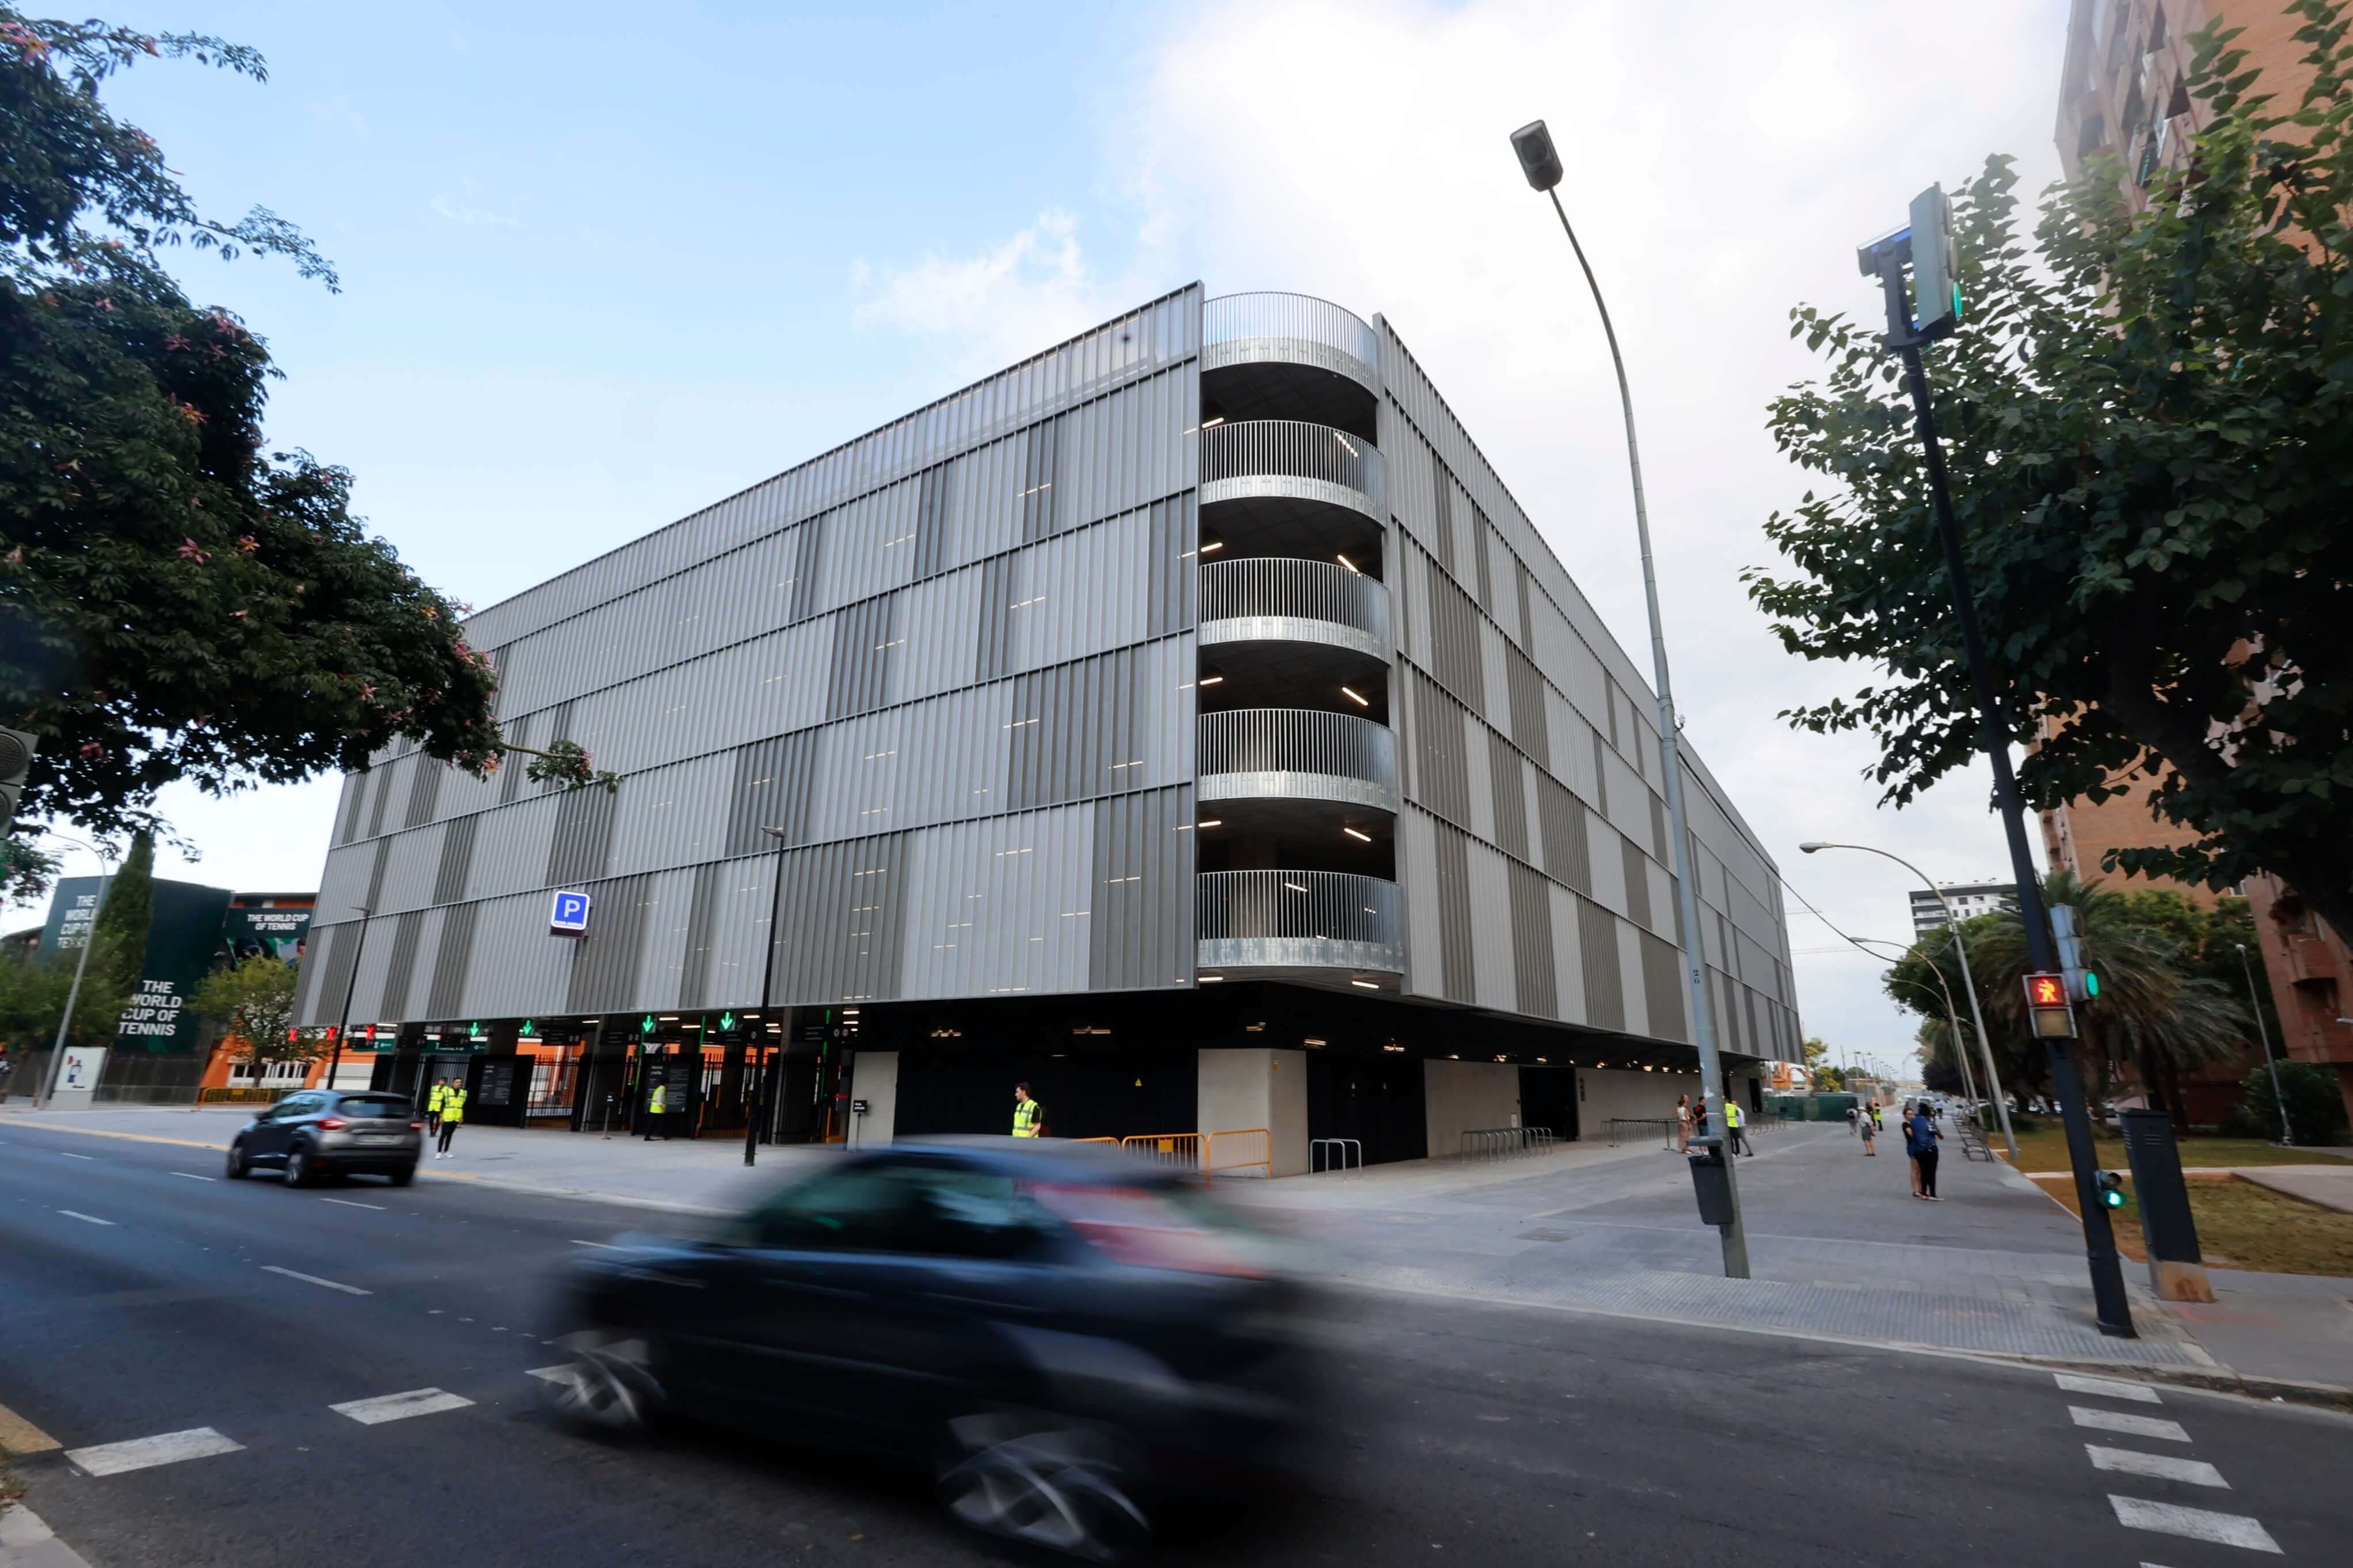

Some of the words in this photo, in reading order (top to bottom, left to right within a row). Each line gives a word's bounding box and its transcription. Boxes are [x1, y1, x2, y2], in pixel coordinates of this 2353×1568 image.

[76, 895, 97, 907] THE
[564, 899, 580, 918] P
[247, 914, 262, 922] THE
[264, 914, 291, 922] WORLD
[292, 914, 310, 922] CUP
[255, 922, 266, 930] OF
[268, 922, 297, 930] TENNIS
[143, 980, 175, 994] THE
[157, 1010, 180, 1022] OF
[119, 1021, 176, 1036] TENNIS
